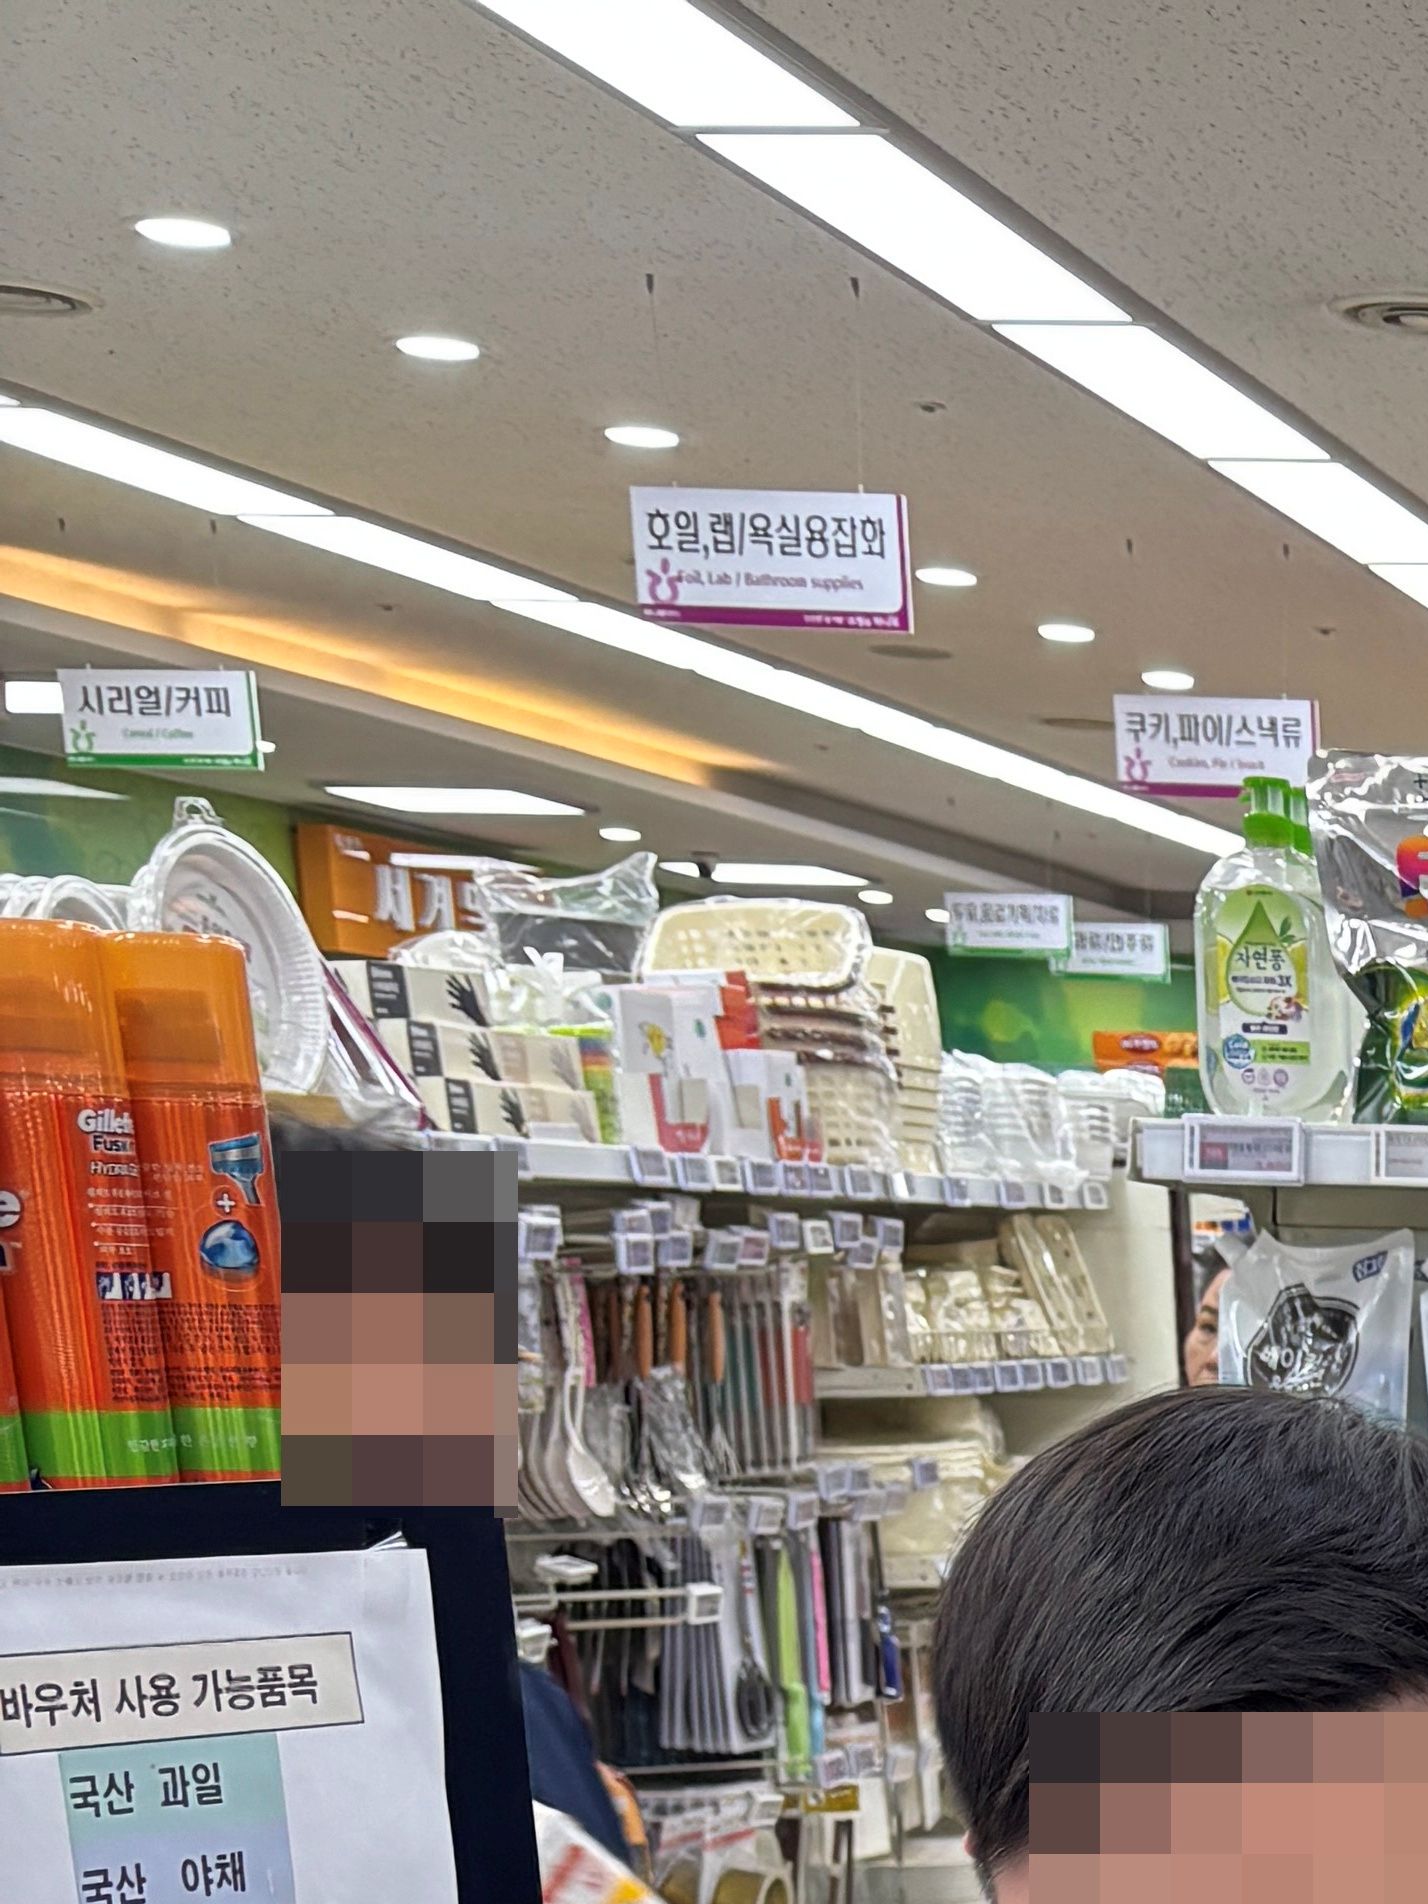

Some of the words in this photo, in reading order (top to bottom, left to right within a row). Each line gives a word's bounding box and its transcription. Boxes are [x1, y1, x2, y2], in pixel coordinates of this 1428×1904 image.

[647, 509, 885, 559] 호일,랩/욕실용잡화
[78, 685, 231, 717] 시리얼/커피
[1125, 712, 1302, 748] 쿠키,파이/스낵류
[115, 1672, 181, 1720] 사용
[193, 1662, 319, 1714] 가능품목
[69, 1771, 135, 1818] 국산
[158, 1762, 223, 1808] 과일
[181, 1850, 247, 1897] 야채
